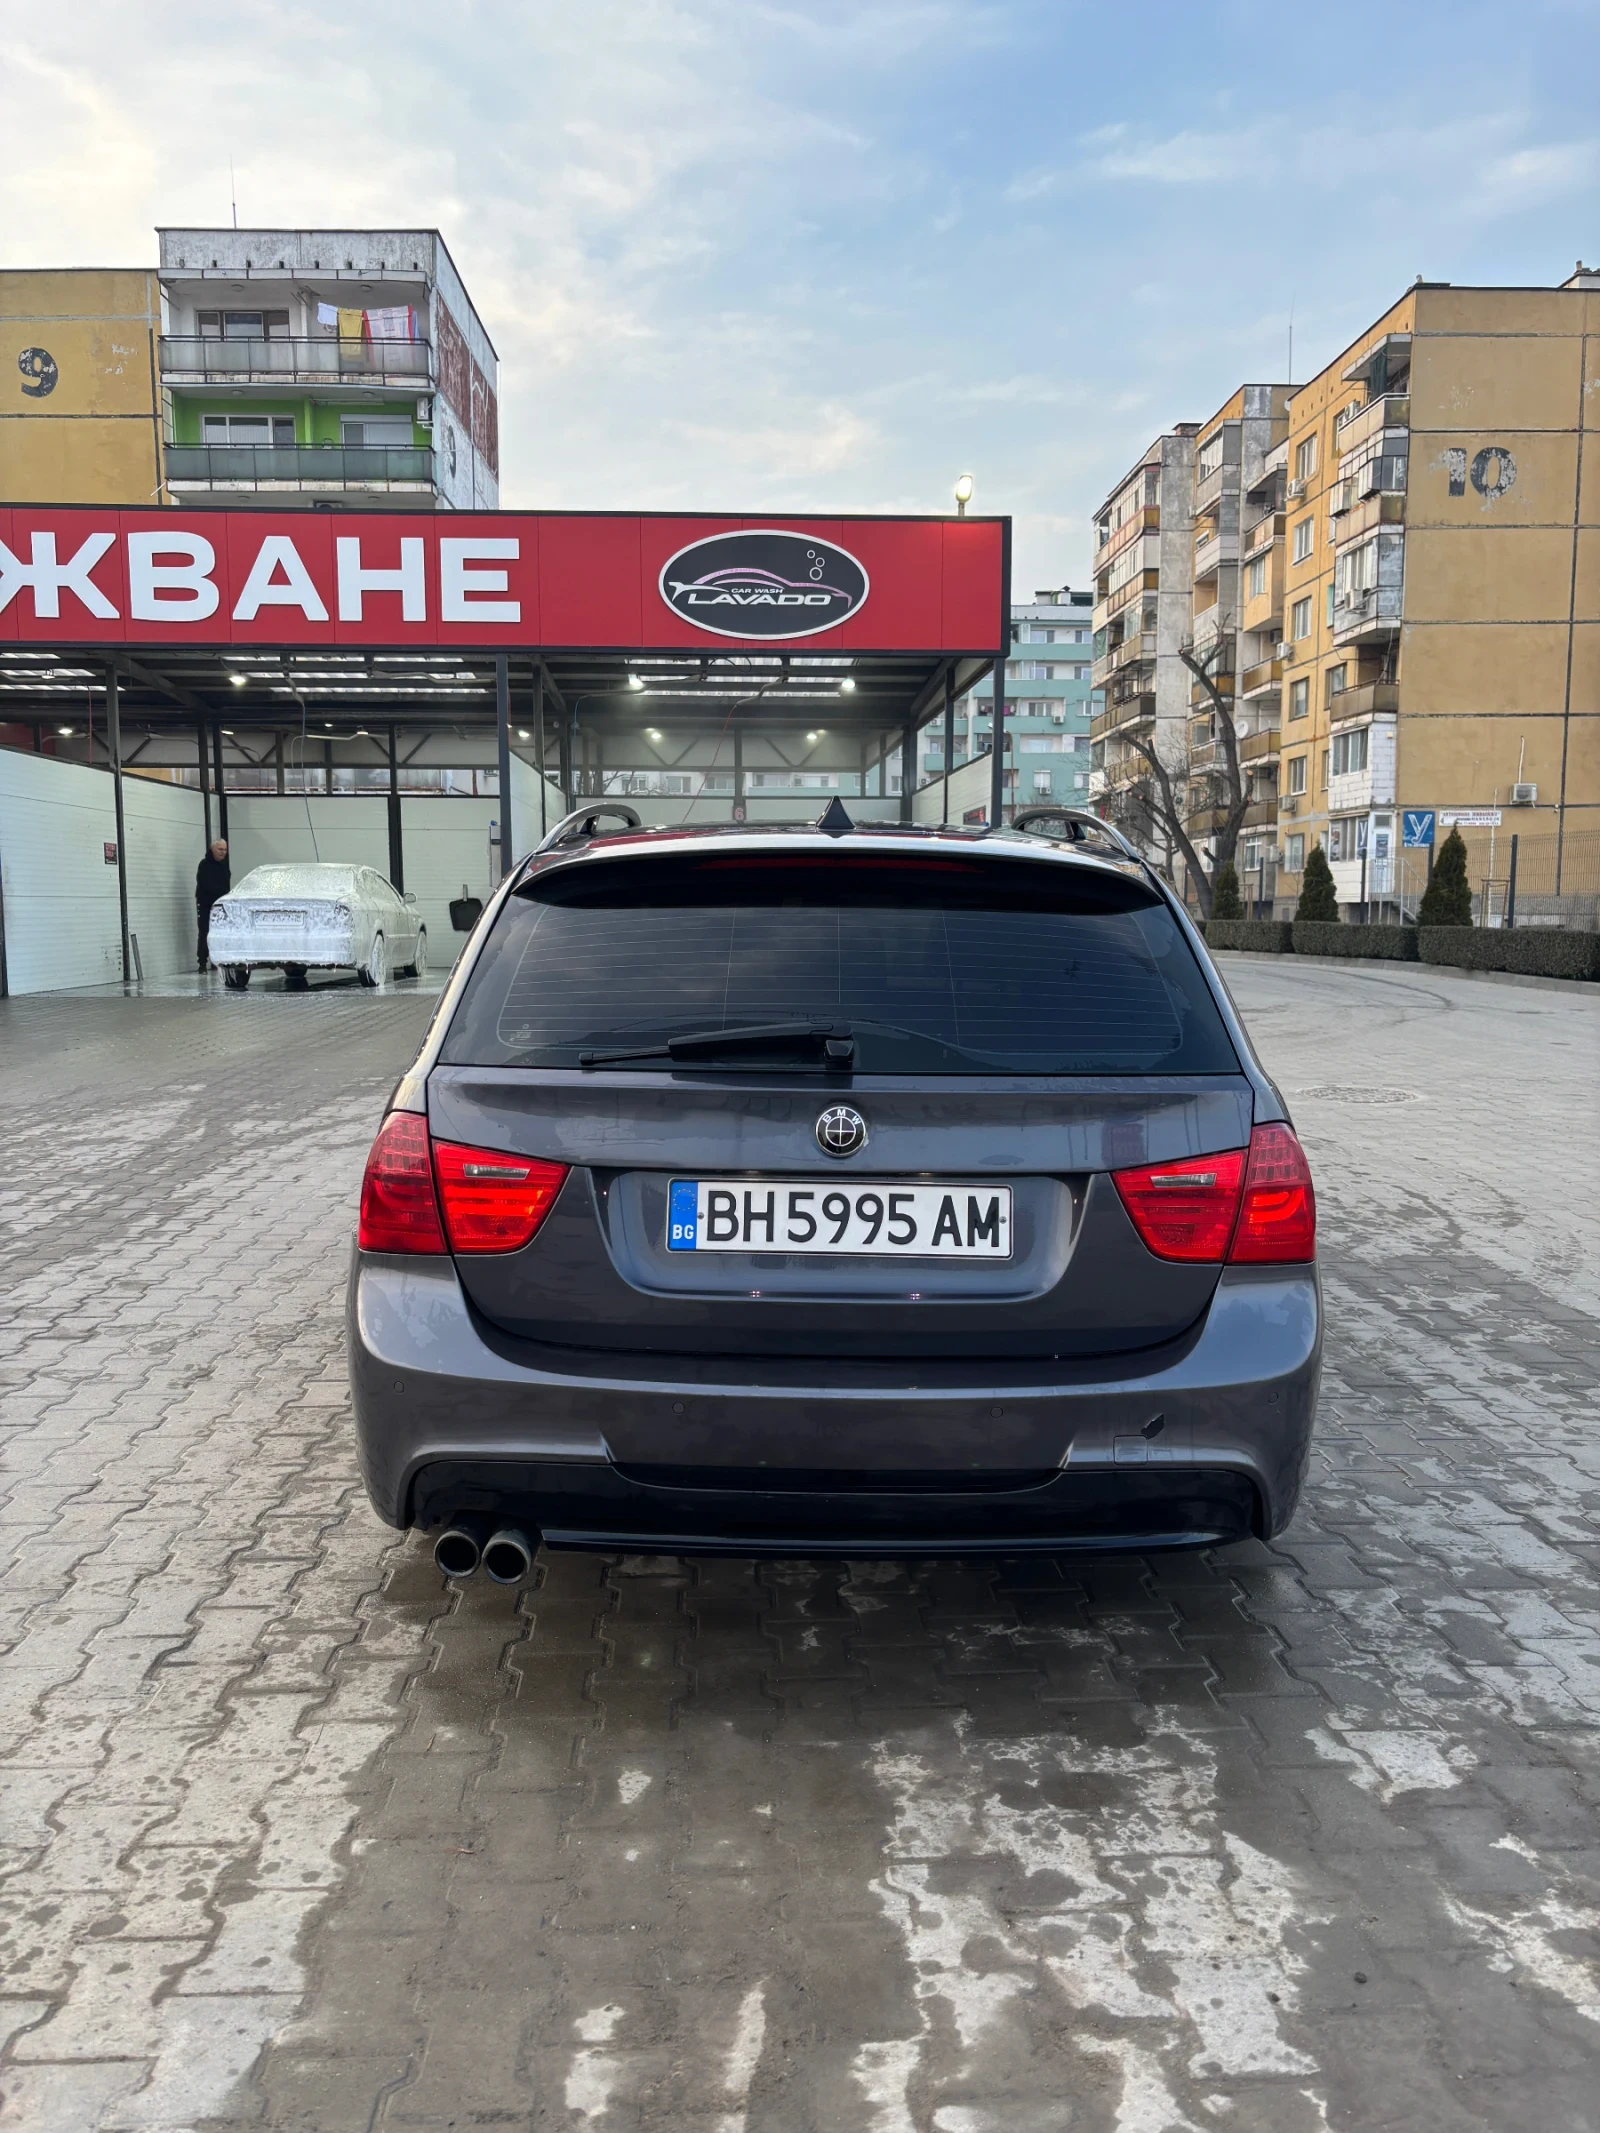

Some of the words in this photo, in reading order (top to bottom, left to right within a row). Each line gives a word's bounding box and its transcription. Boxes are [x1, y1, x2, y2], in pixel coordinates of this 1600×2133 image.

[18, 347, 59, 398] 9
[1444, 447, 1517, 498] 10
[0, 530, 521, 623] ЖВАНЕ
[688, 594, 831, 605] LAVADO
[822, 1108, 861, 1125] BMW
[672, 1224, 694, 1240] BG
[787, 1191, 917, 1245] 5995
[931, 1195, 999, 1247] AM
